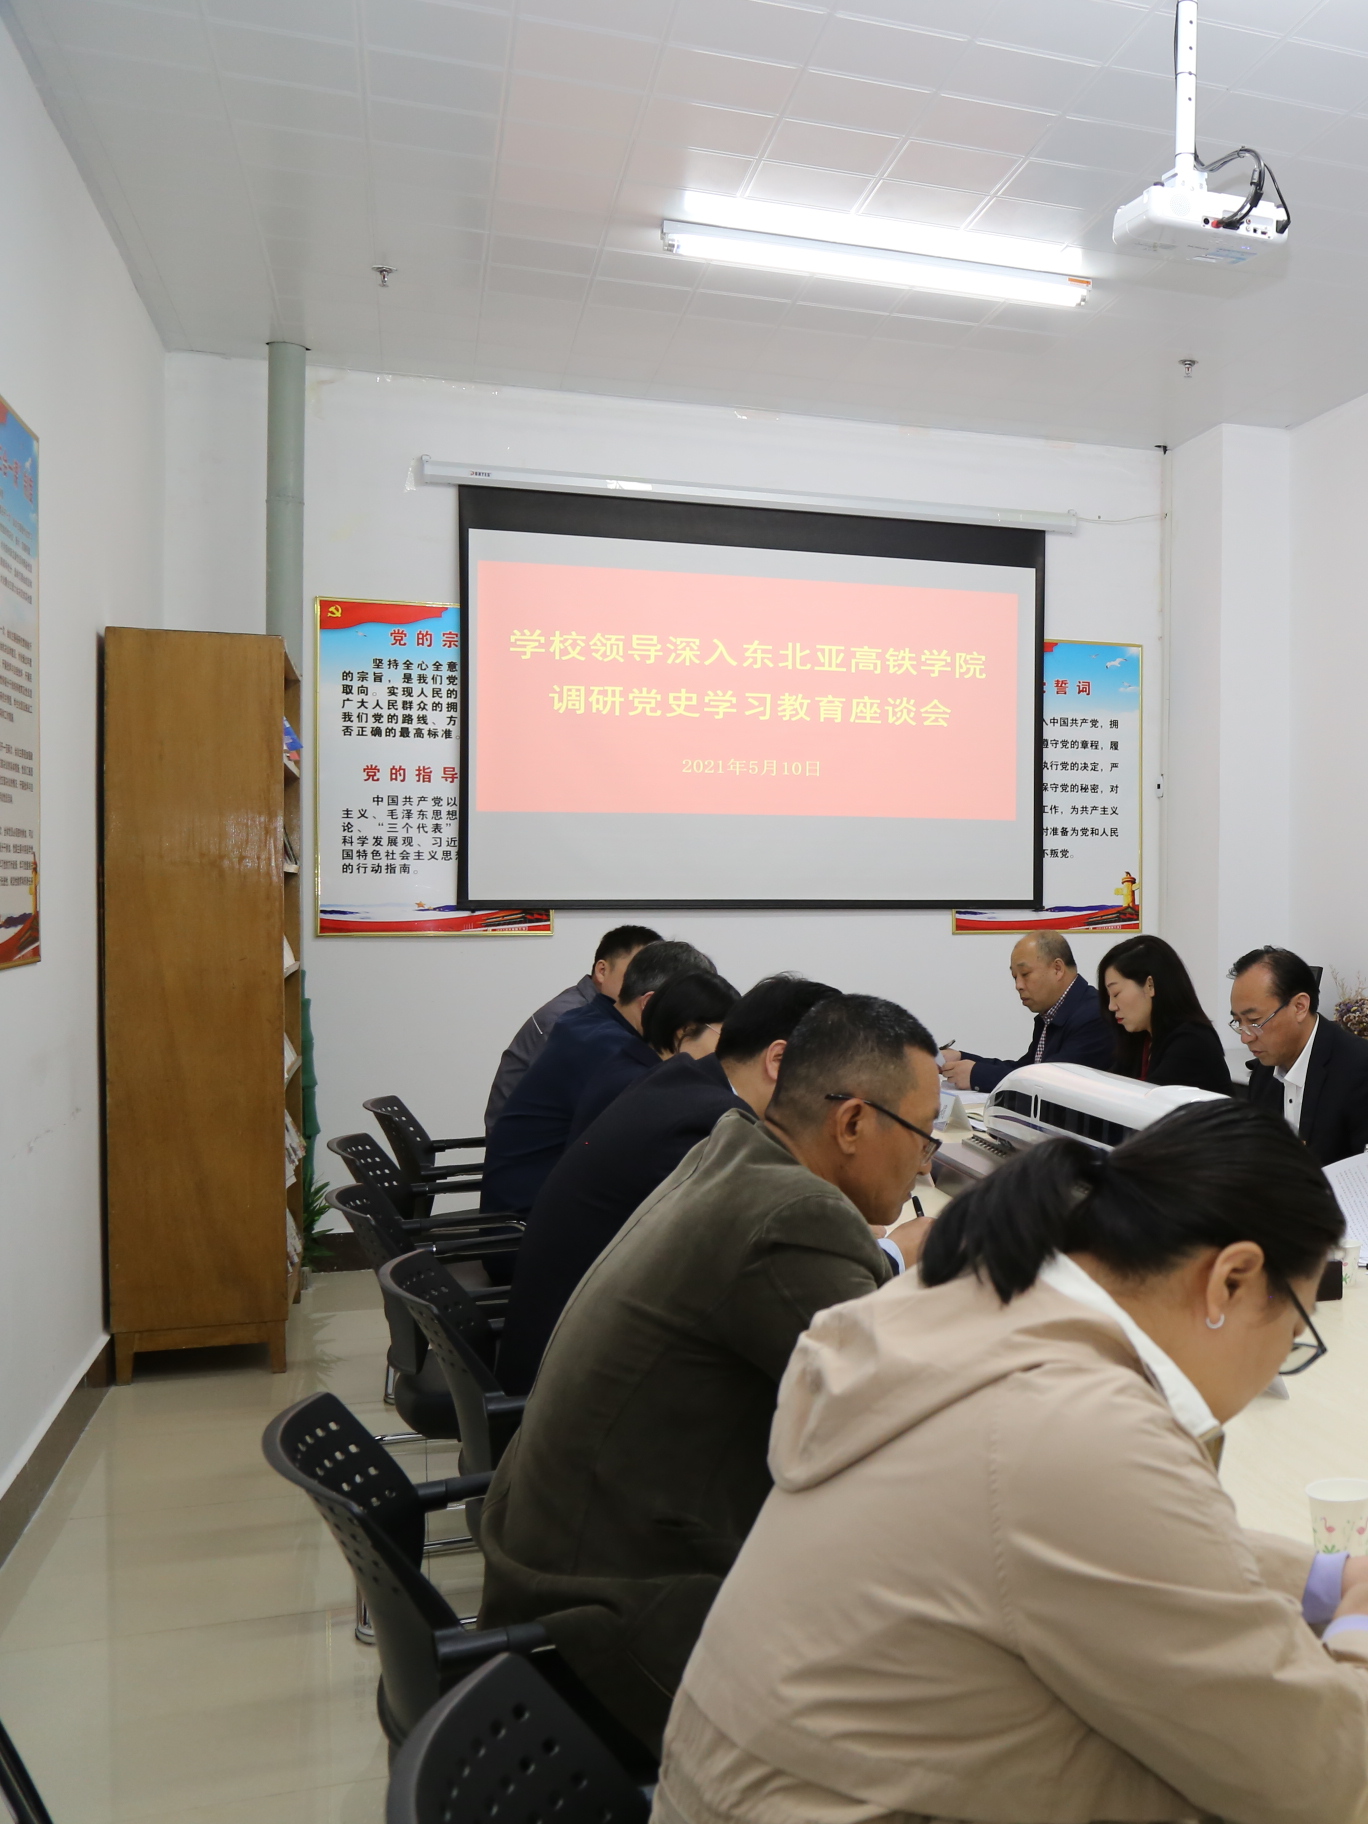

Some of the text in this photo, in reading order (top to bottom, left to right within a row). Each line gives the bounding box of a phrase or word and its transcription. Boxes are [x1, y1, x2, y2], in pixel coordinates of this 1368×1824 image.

[390, 629, 459, 648] 党的宗
[509, 629, 986, 679] 学校领导深入东北亚高铁学院
[372, 658, 458, 672] 坚持全心全意
[341, 671, 458, 686] 的宗旨，是我们党
[341, 684, 458, 699] 取向。实现人民的
[1043, 679, 1091, 695] 誓词
[341, 698, 458, 713] 广大人民群众的拥
[549, 684, 951, 727] 调研党史学习教育座谈会
[341, 712, 458, 726] 我们党的路线、方
[341, 726, 460, 740] 否正确的最高标准。
[363, 764, 458, 783] 党的指导
[682, 758, 821, 777] 2021年5月10日
[372, 795, 458, 807] 中国共产党以
[341, 808, 458, 820] 主义、毛泽东思想
[341, 835, 458, 848] 科学发展观、习近
[341, 862, 418, 875] 的行动指南。
